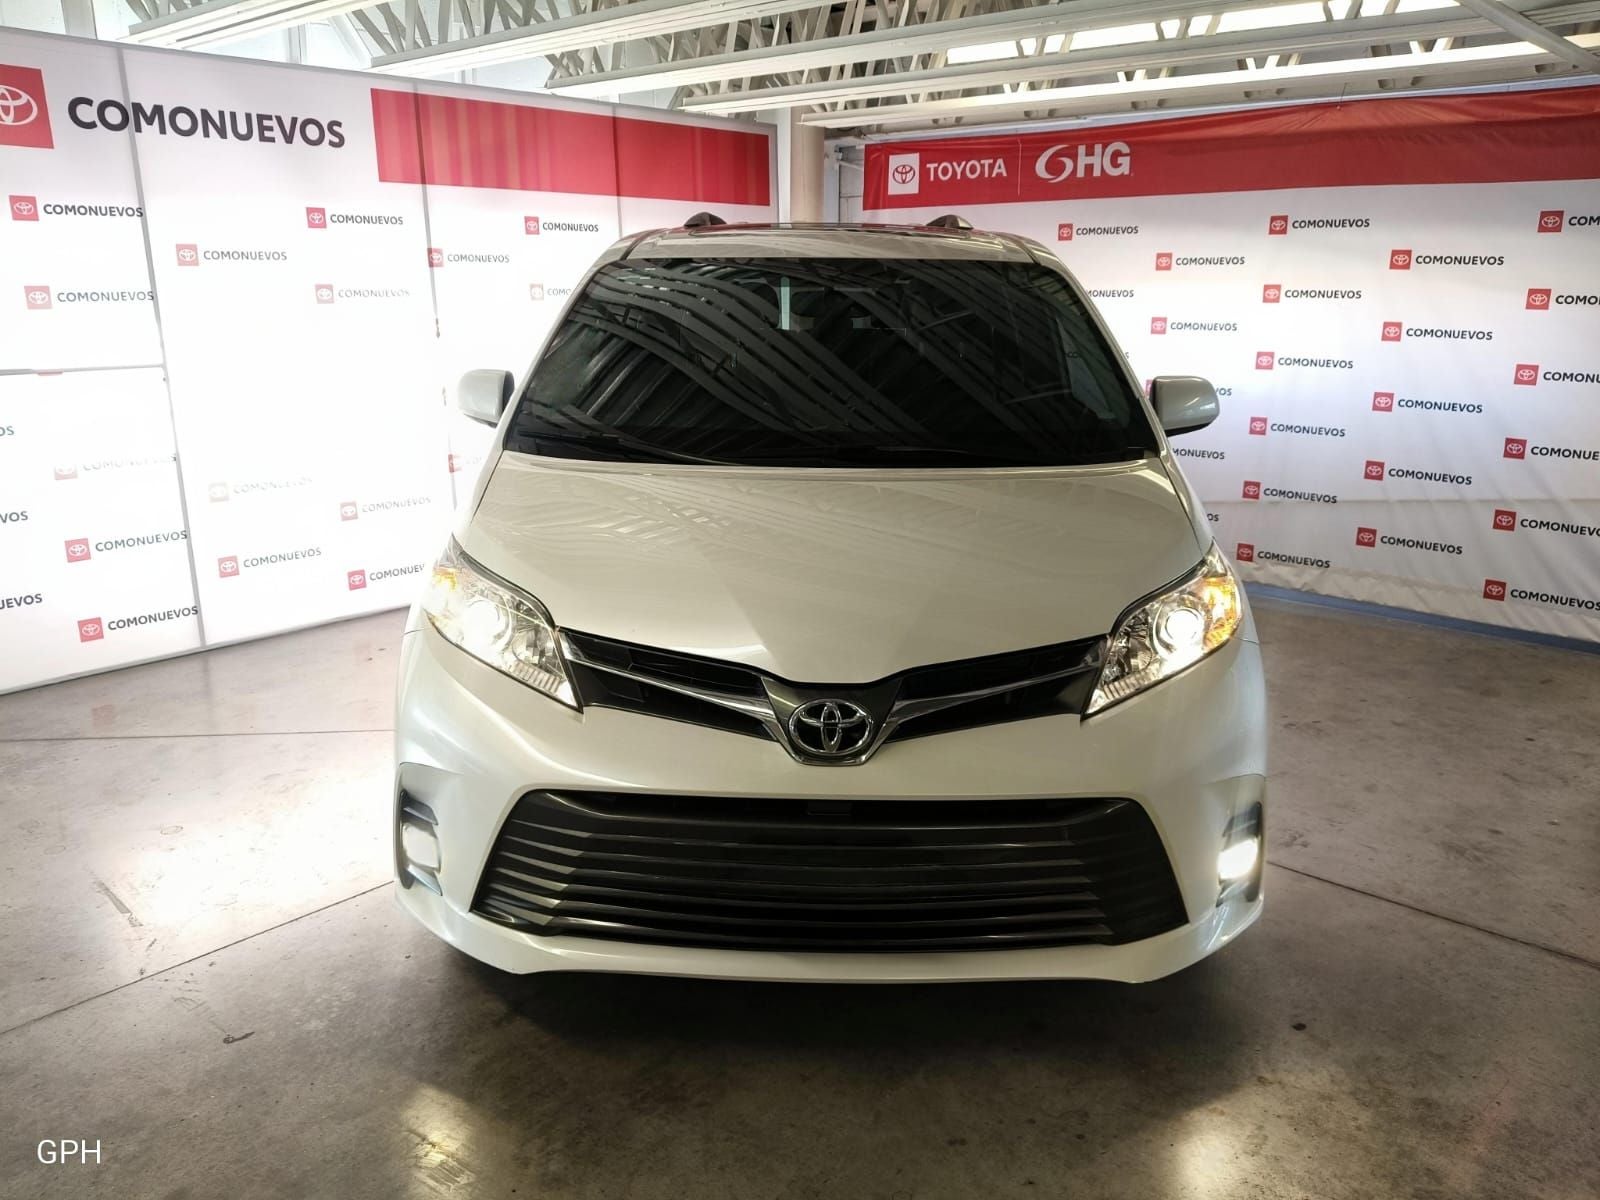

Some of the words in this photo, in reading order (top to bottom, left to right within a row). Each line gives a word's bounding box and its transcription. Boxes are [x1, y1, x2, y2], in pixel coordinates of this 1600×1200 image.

[68, 97, 345, 148] COMONUEVOS
[926, 158, 1007, 181] TOYOTA
[43, 204, 143, 217] COMONUEVOS
[330, 214, 404, 225] COMONUEVOS
[1292, 218, 1370, 229] COMONUEVOS
[542, 221, 599, 233] COMONUEVOS
[1076, 226, 1139, 236] COMONUEVOS
[203, 250, 287, 261] COMONUEVOS
[447, 253, 510, 263] COMONUEVOS
[1175, 256, 1245, 266] COMONUEVOS
[1415, 255, 1504, 266] COMONUEVOS
[57, 291, 154, 302] COMONUEVOS
[1284, 290, 1362, 300] COMONUEVOS
[1555, 295, 1600, 305] COMO
[1170, 322, 1238, 332] COMONUEVOS
[1406, 328, 1493, 341] COMONUEVOS
[1278, 357, 1354, 369] COMONUEVOS
[1398, 399, 1483, 414] COMONUEVOS
[1270, 423, 1346, 437] COMONUEVOS
[1388, 468, 1472, 485] COMONUEVOS
[1263, 487, 1338, 504] COMONUEVOS
[95, 530, 188, 552] COMONUEVOS
[1380, 535, 1463, 555] COMONUEVOS
[243, 547, 322, 568] COMONUEVOS
[1257, 550, 1331, 569] COMONUEVOS
[108, 605, 199, 630] COMONUEVOS
